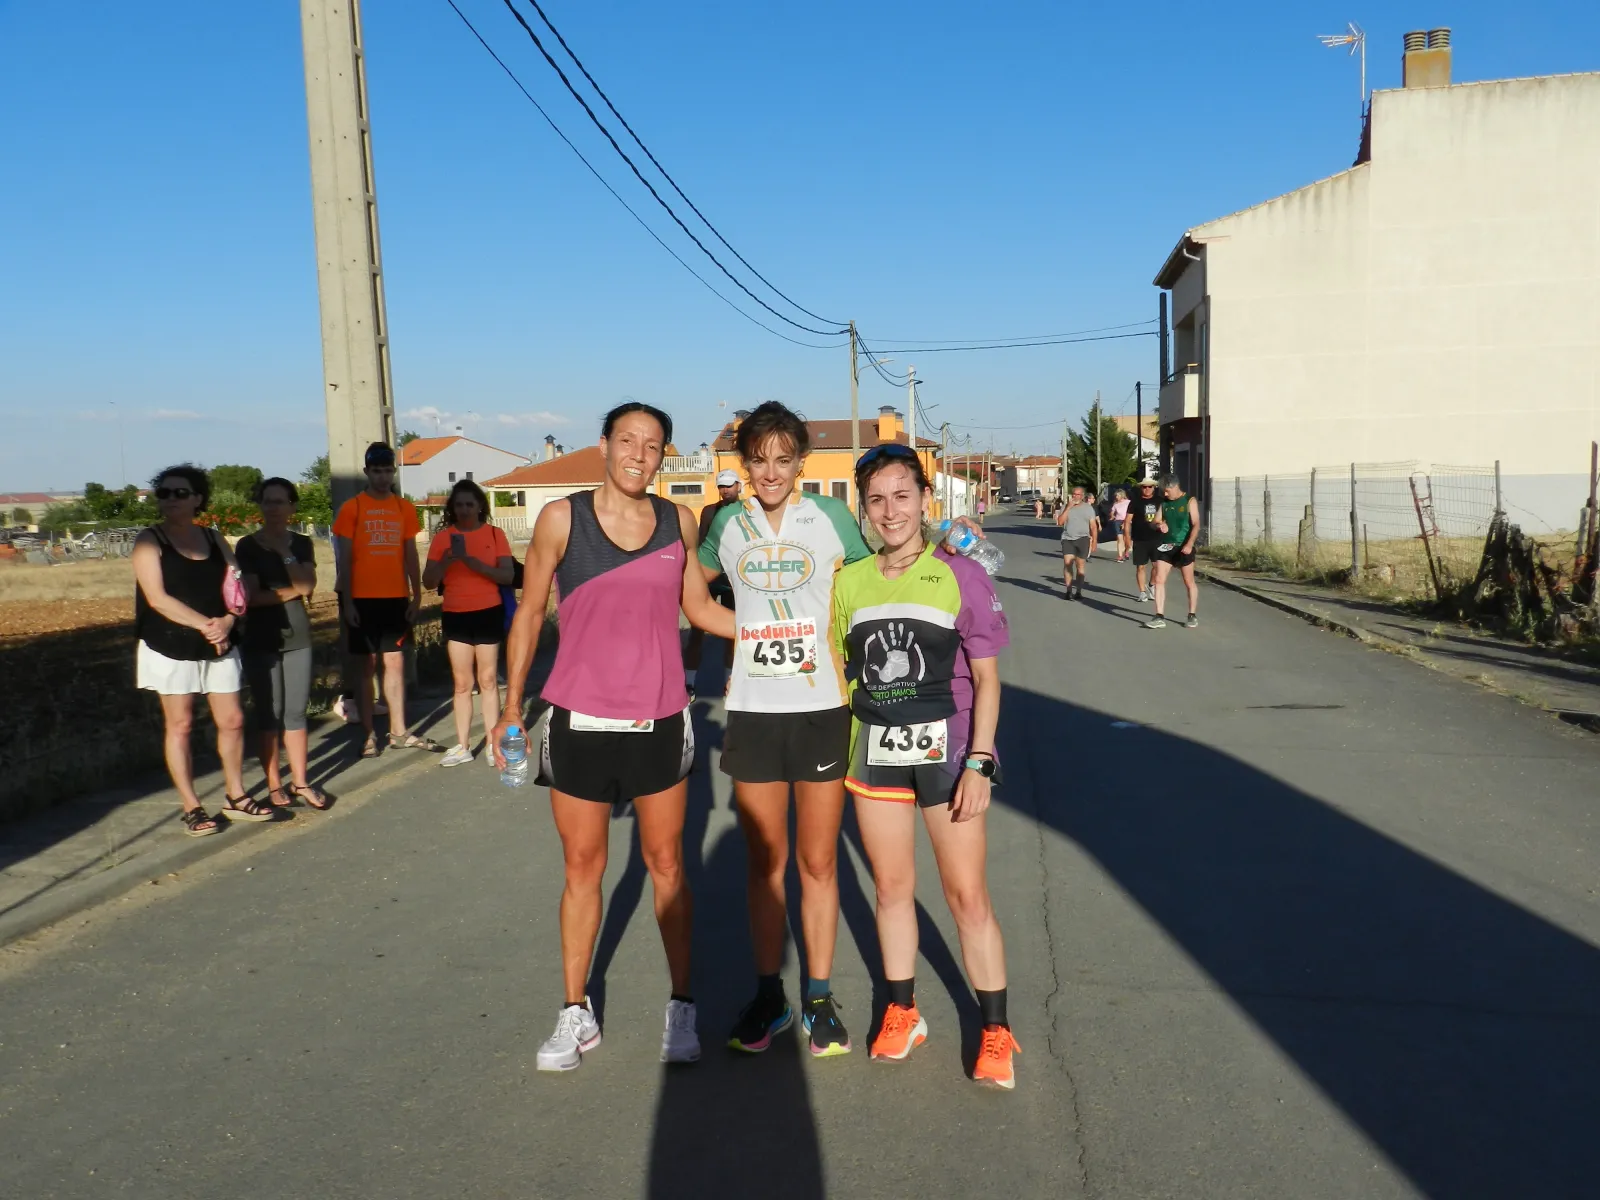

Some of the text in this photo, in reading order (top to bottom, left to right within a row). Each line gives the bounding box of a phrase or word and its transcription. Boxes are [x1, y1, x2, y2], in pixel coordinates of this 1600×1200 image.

[743, 560, 806, 576] ALCER
[753, 638, 805, 666] 435
[878, 681, 917, 691] DEPORTIVO
[891, 688, 917, 698] RAMOS
[879, 725, 933, 752] 436
